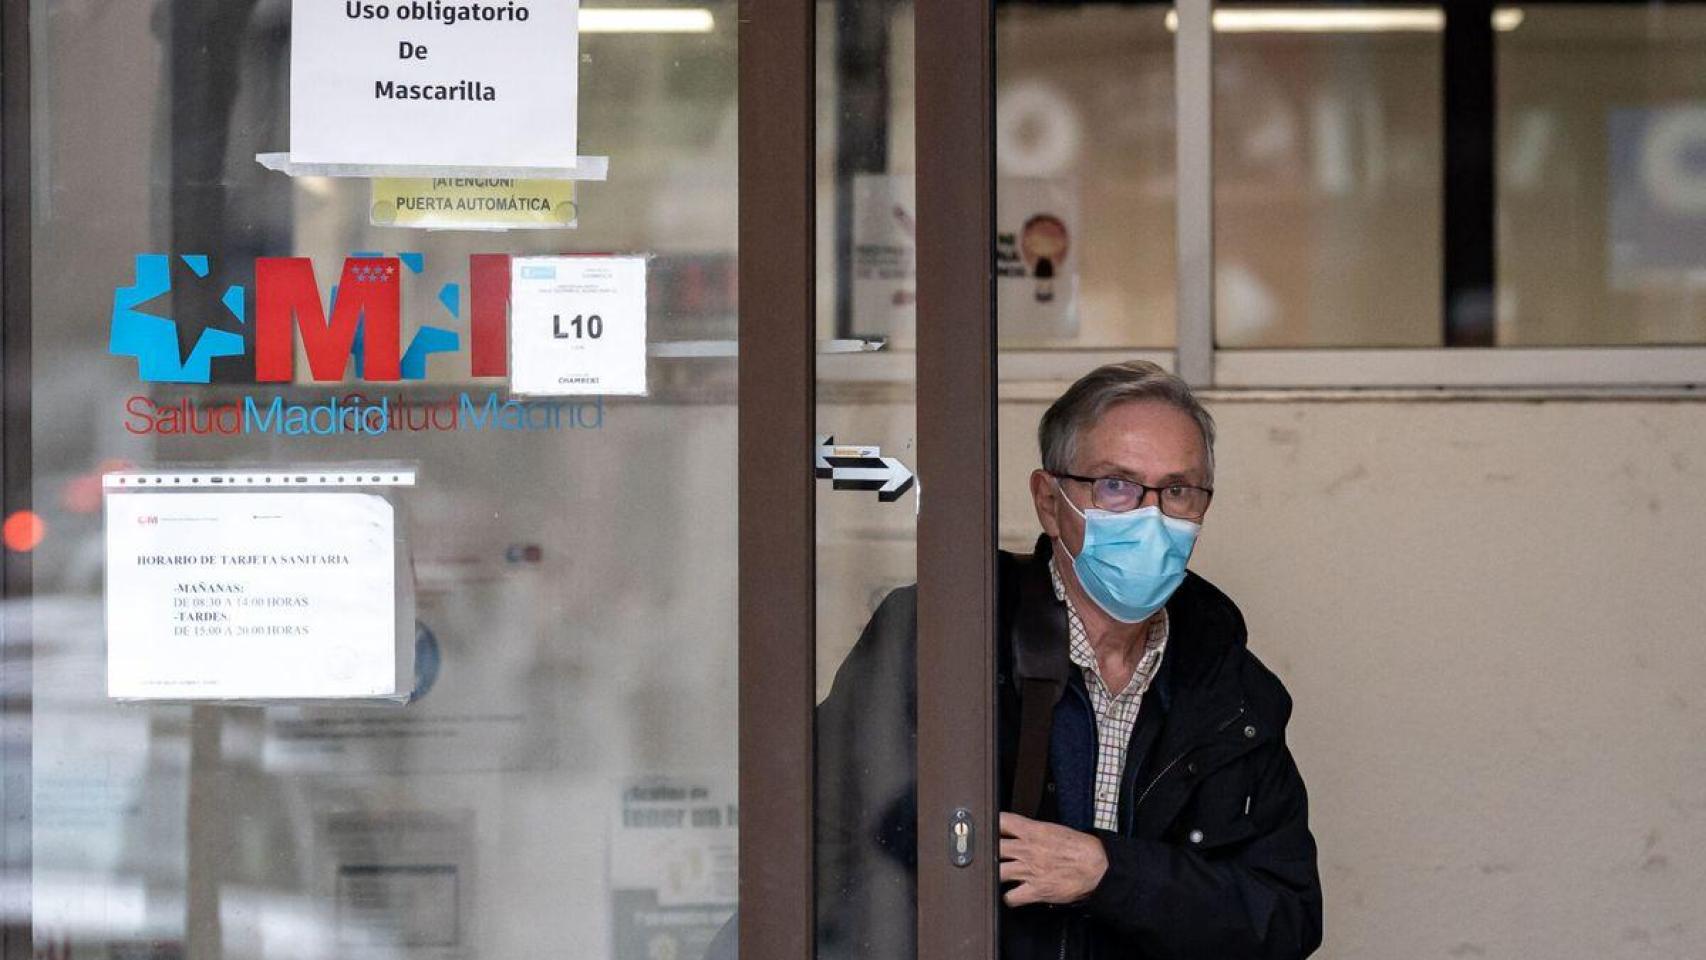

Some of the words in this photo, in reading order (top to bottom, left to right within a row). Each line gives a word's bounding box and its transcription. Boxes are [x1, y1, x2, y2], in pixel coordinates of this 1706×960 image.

[346, 1, 390, 20] Uso
[396, 1, 530, 26] obligatorio
[398, 41, 428, 60] De
[375, 80, 496, 101] Mascarilla
[396, 197, 453, 211] PUERTA
[456, 195, 551, 211] AUTOMÁTICA
[552, 313, 604, 339] L10
[137, 554, 198, 566] HORARIO
[200, 554, 217, 566] DE
[221, 554, 278, 566] TARJETA
[280, 554, 350, 566] SANITARIA
[174, 597, 190, 608] DE
[224, 597, 233, 608] A
[266, 596, 309, 607] HORAS
[174, 625, 190, 636] DE
[224, 625, 233, 636] A
[266, 625, 309, 636] HORAS
